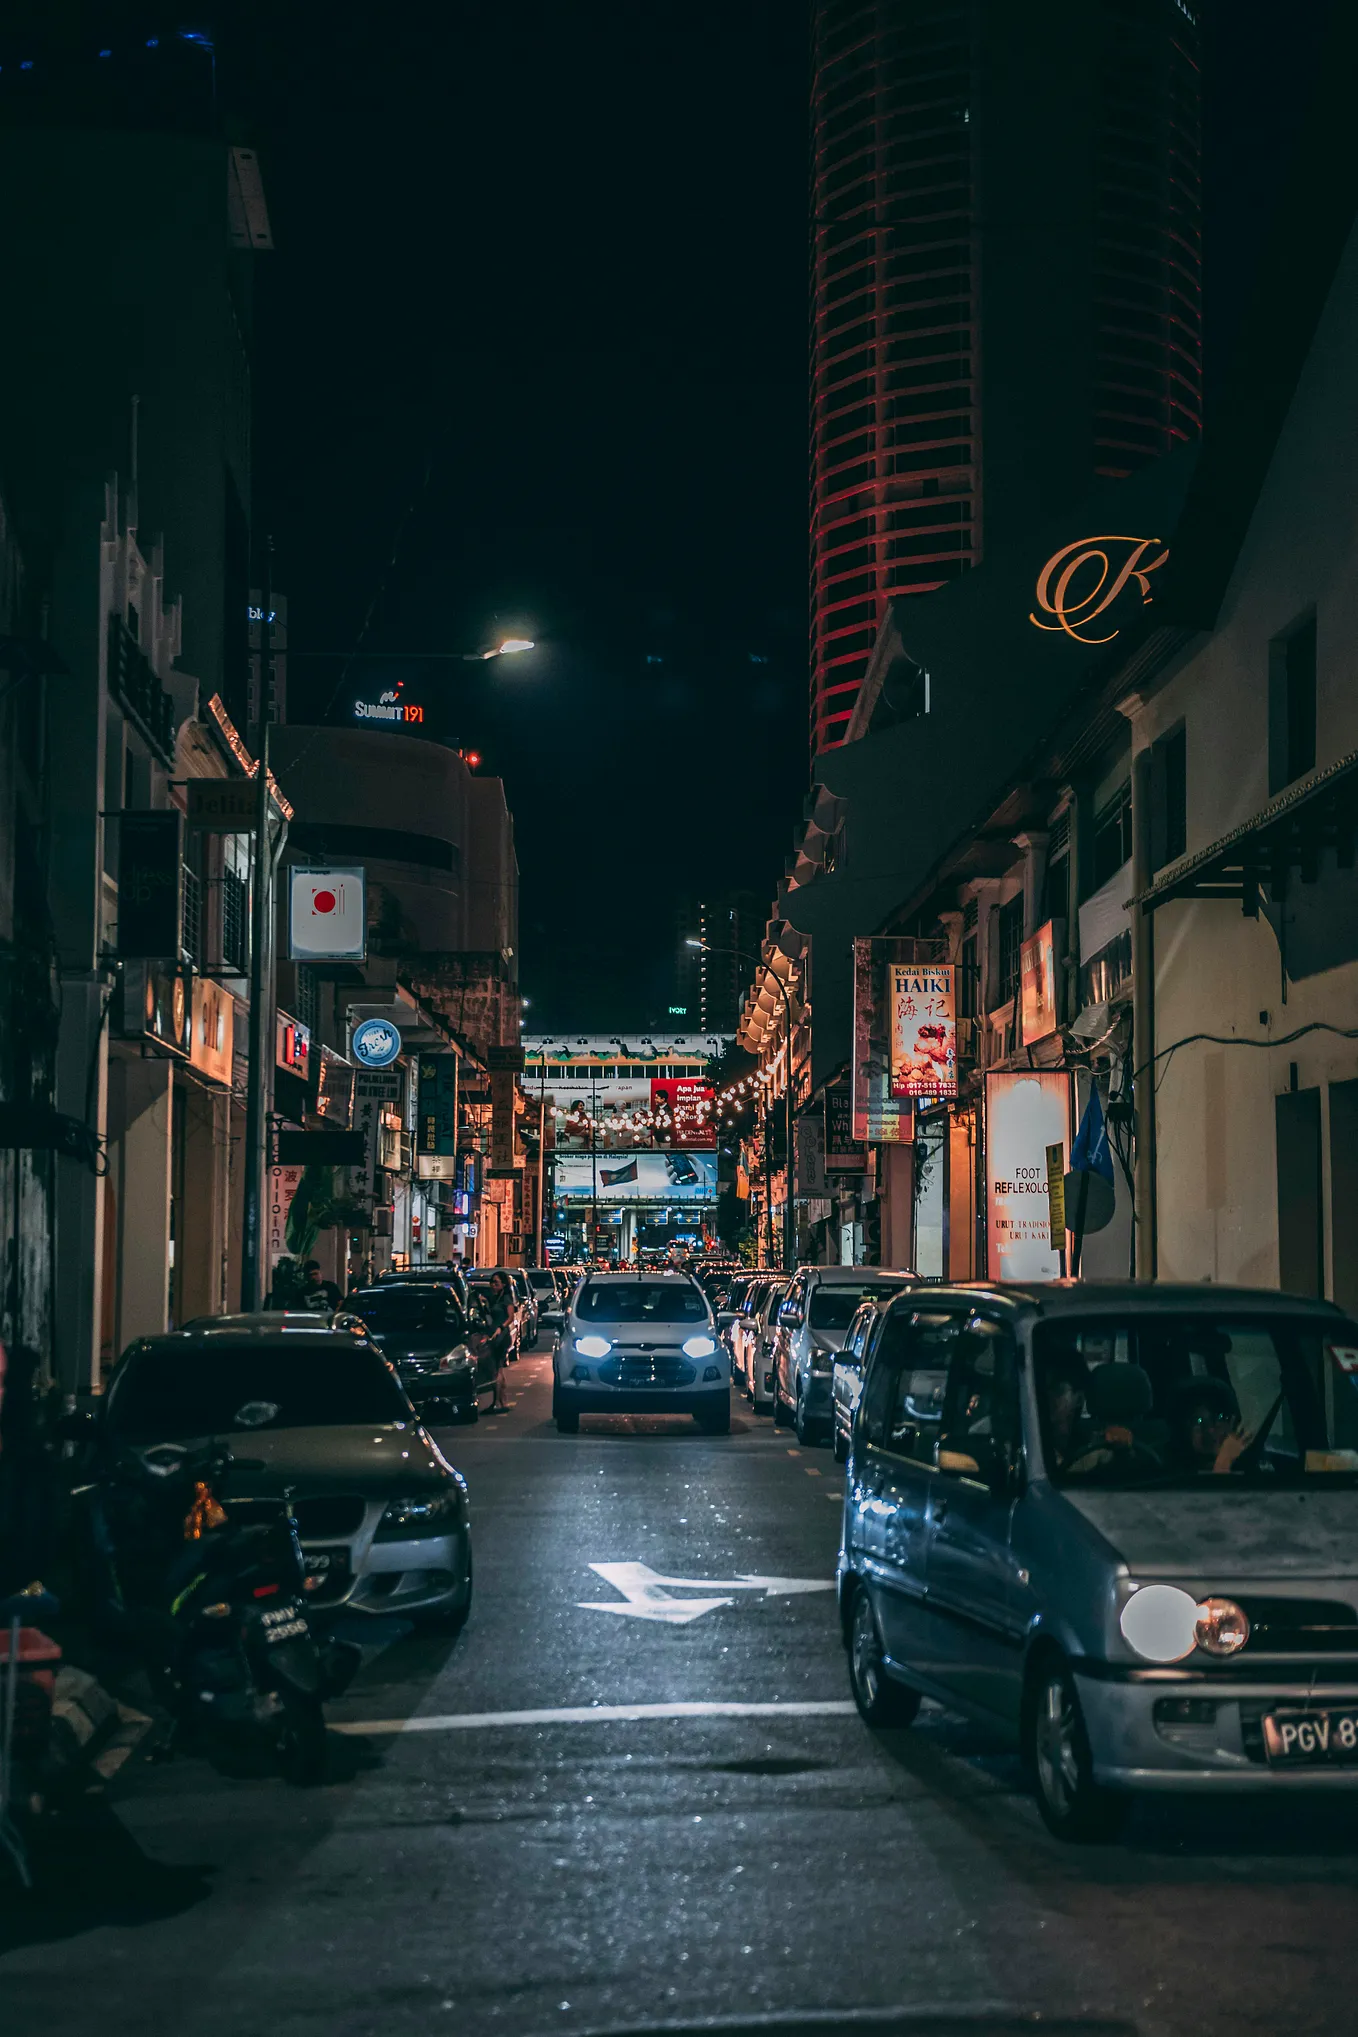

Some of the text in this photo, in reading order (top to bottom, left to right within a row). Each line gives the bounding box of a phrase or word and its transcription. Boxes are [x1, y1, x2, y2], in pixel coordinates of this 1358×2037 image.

[355, 701, 423, 722] SUMMIT 191
[895, 967, 950, 976] Kedai Biskut
[895, 978, 951, 993] HAIKI
[676, 1084, 692, 1093] Apa
[1016, 1168, 1040, 1179] FOOT
[995, 1182, 1049, 1193] REFLEXOLO
[996, 1220, 1014, 1229] URUT
[1281, 1717, 1358, 1754] PGV 8
